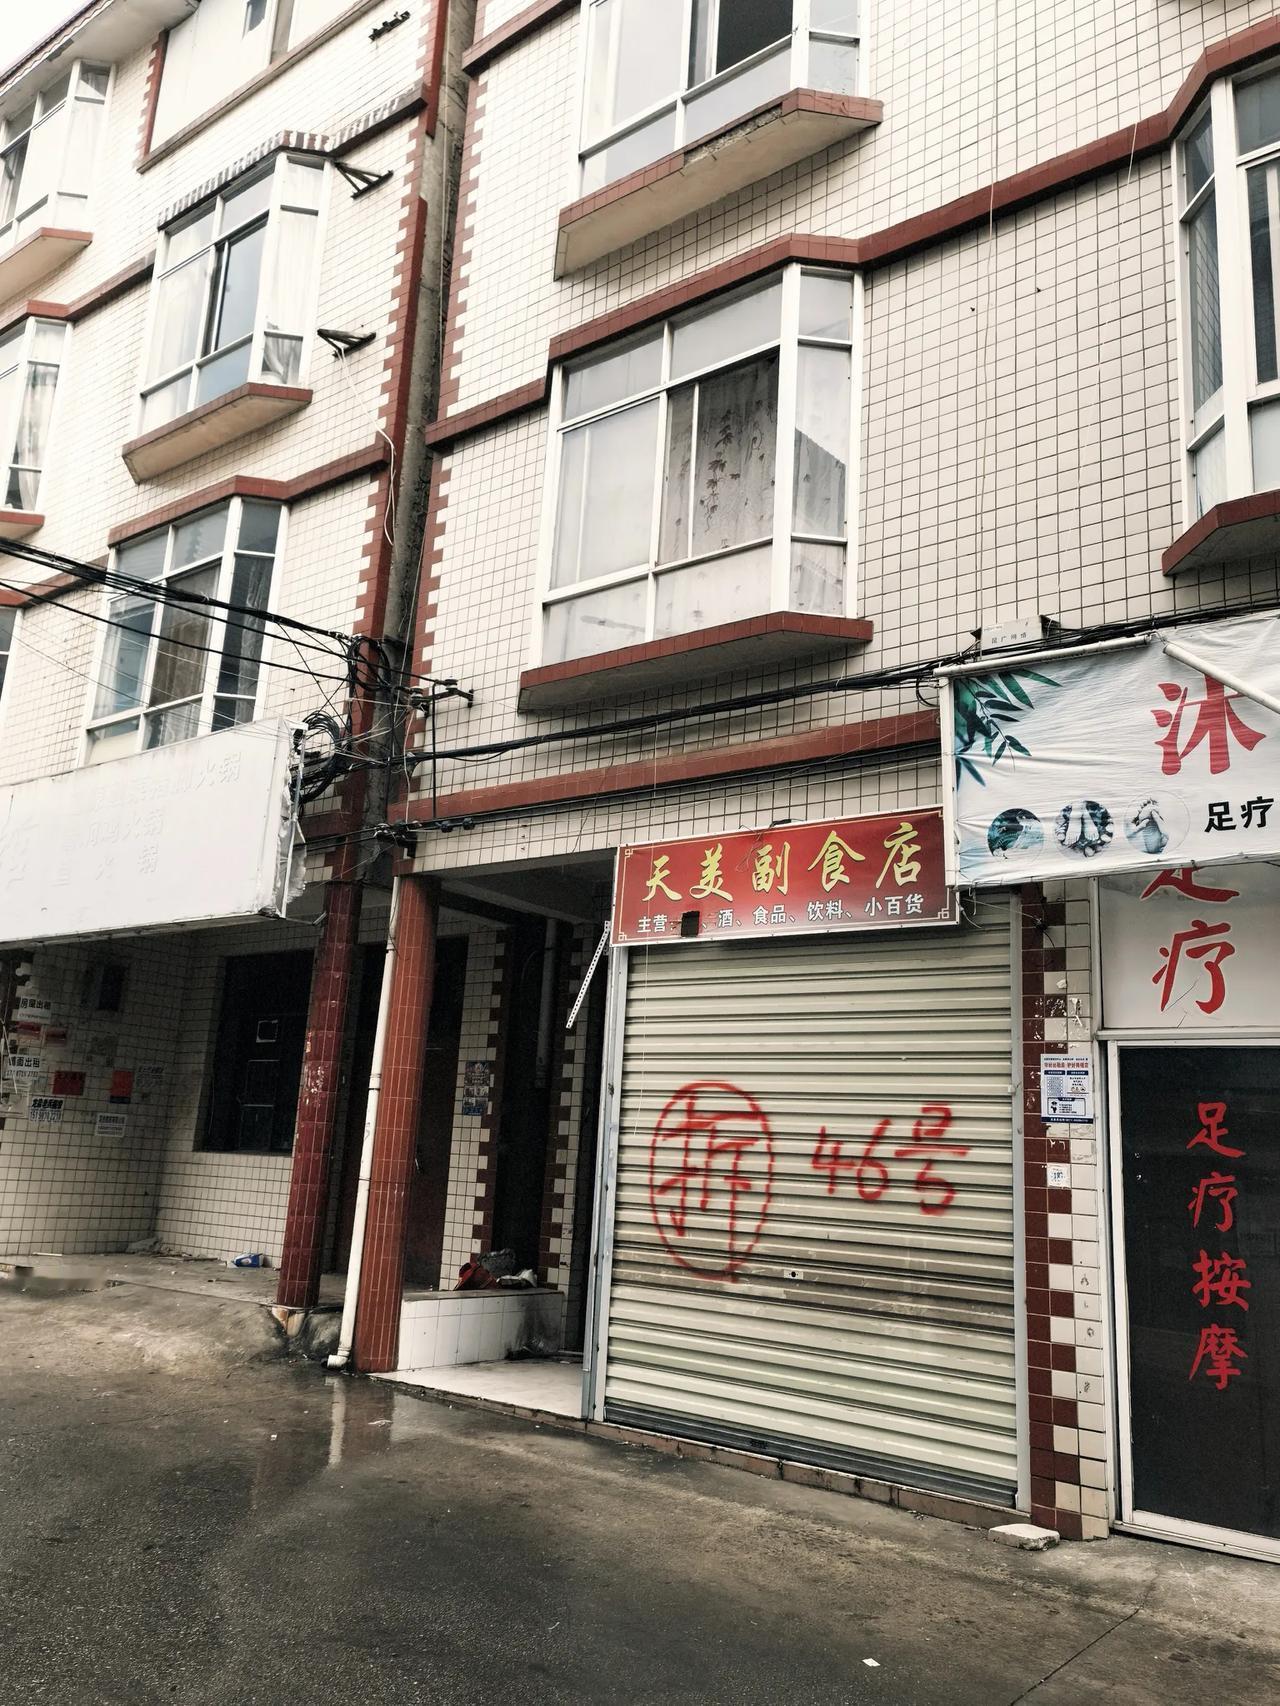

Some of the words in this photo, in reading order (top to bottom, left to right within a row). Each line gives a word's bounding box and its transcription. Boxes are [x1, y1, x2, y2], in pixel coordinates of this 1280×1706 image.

[1204, 796, 1275, 834] 足疗
[642, 822, 923, 902] 天美副食店
[1187, 1102, 1252, 1391] 足疗按摩
